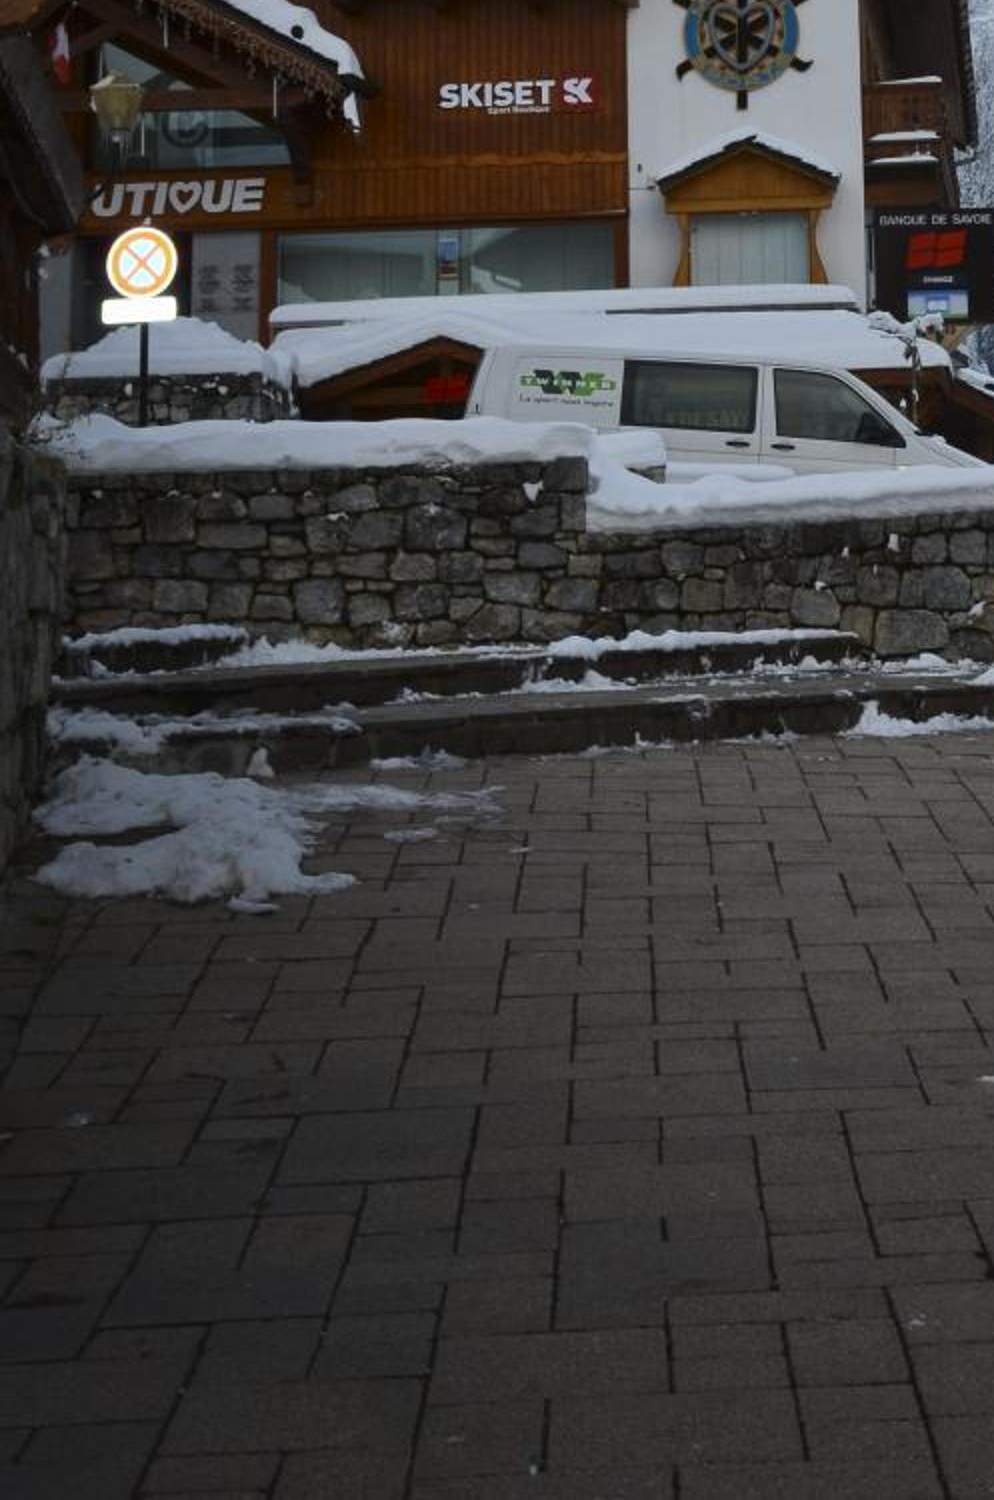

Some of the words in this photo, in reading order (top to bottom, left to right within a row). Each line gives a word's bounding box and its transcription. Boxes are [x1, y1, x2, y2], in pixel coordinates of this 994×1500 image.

[439, 79, 556, 109] SKISET
[879, 214, 928, 226] BANQUE
[931, 214, 948, 225] DE
[951, 213, 993, 225] SAVOIE
